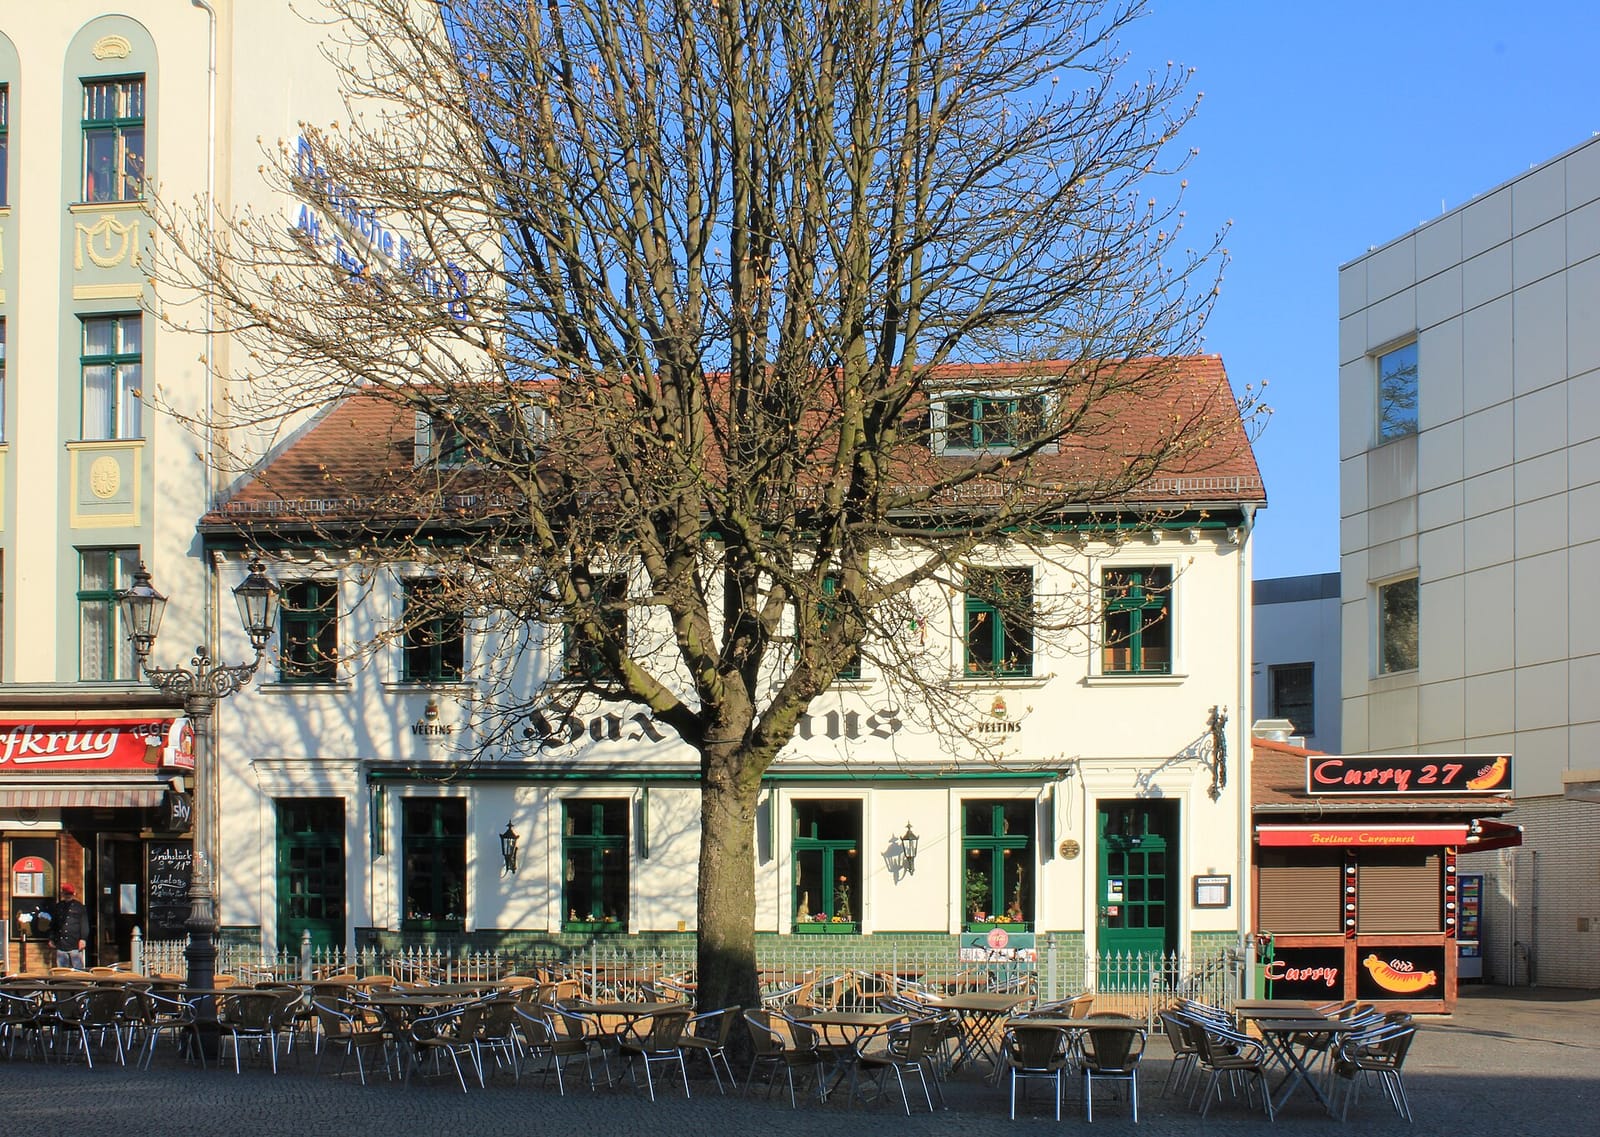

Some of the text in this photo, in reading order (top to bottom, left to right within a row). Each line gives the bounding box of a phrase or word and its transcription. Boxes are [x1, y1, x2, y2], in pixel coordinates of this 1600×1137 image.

[412, 724, 453, 735] VELTINS
[977, 722, 1022, 733] VELTINS
[1313, 759, 1463, 792] Curry 27
[173, 800, 190, 822] sky
[1310, 833, 1415, 845] Berliner Currywurst
[1263, 960, 1338, 987] Curry
